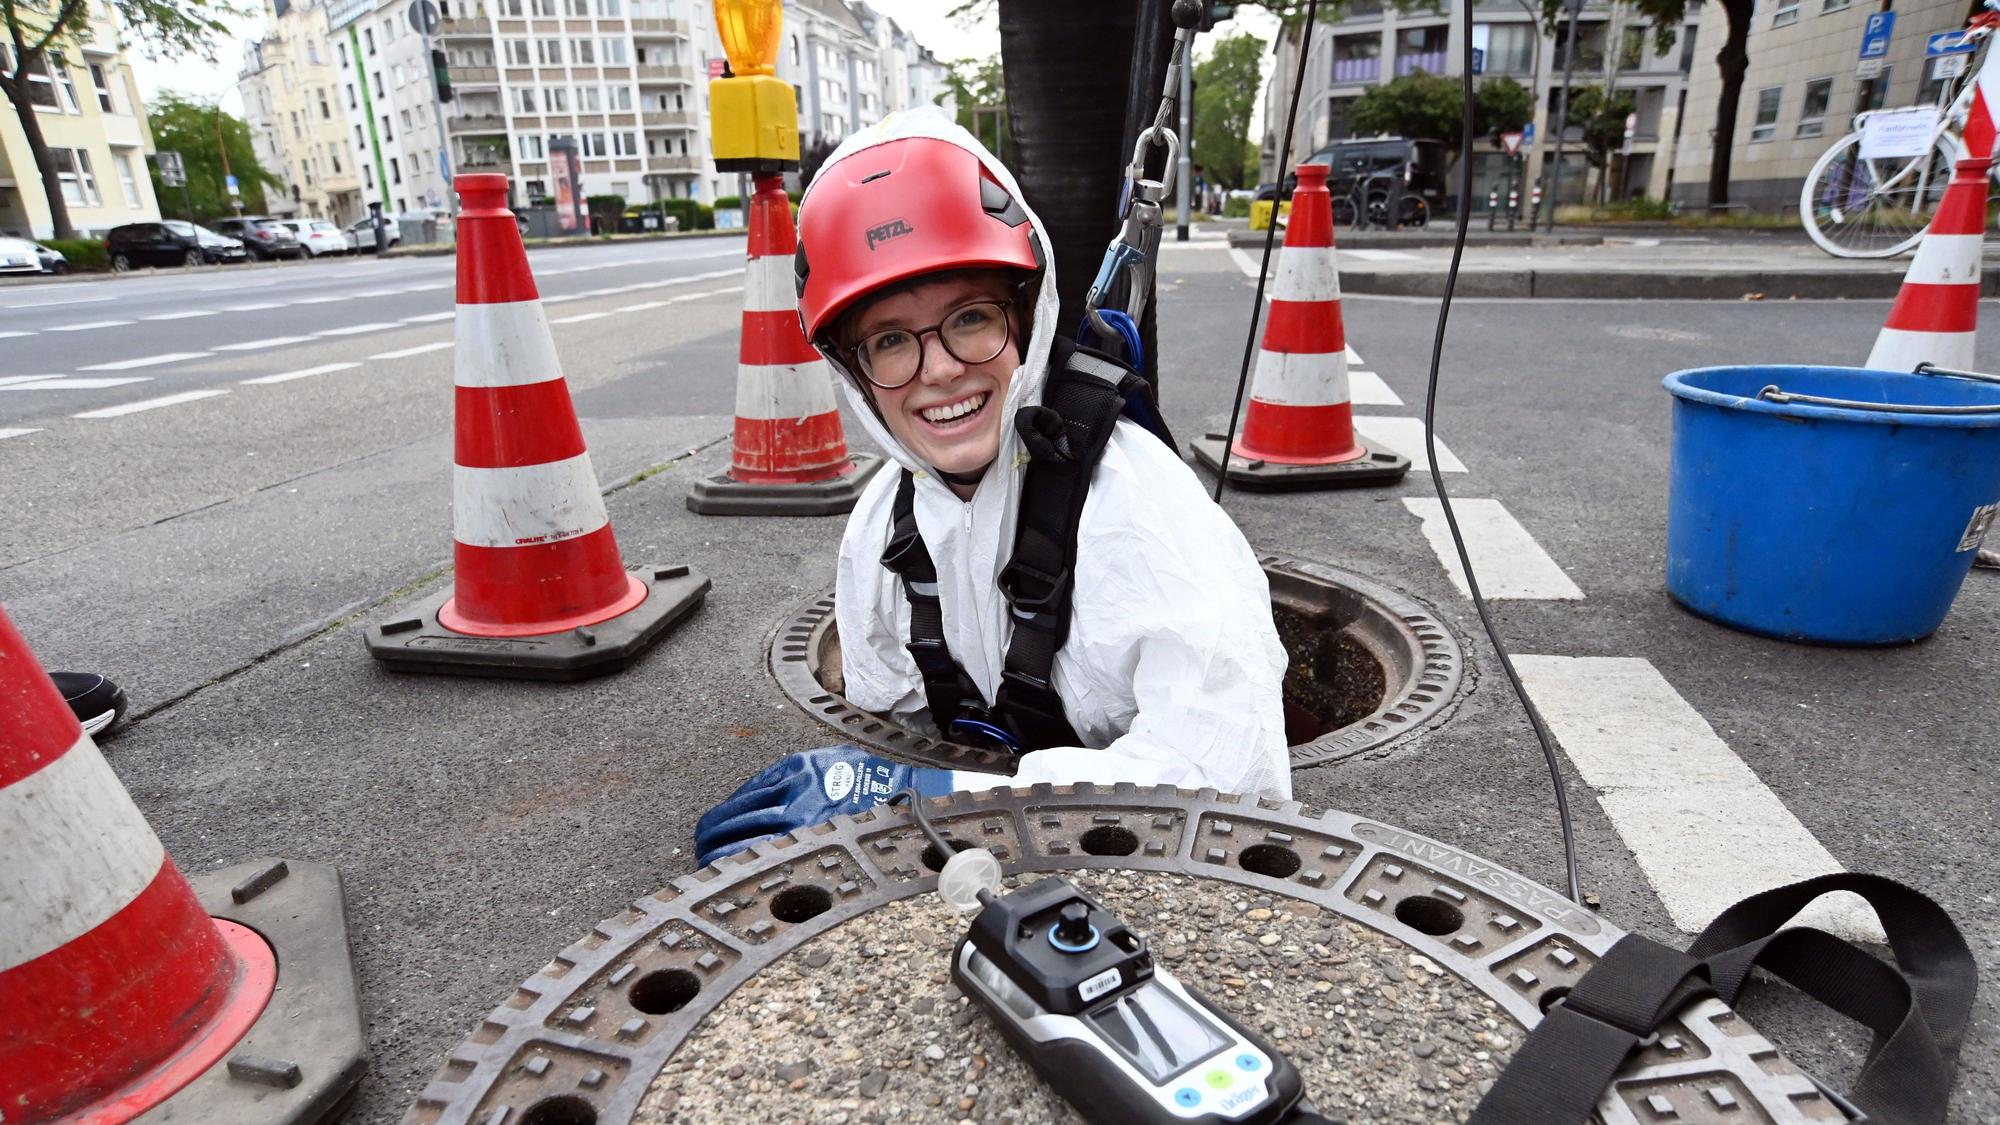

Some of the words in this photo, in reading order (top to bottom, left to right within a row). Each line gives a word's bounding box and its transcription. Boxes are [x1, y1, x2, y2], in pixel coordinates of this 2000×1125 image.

[1868, 15, 1882, 34] P
[866, 220, 914, 251] PETZL
[830, 764, 844, 797] STRONG
[1383, 836, 1573, 923] PASSAVANT
